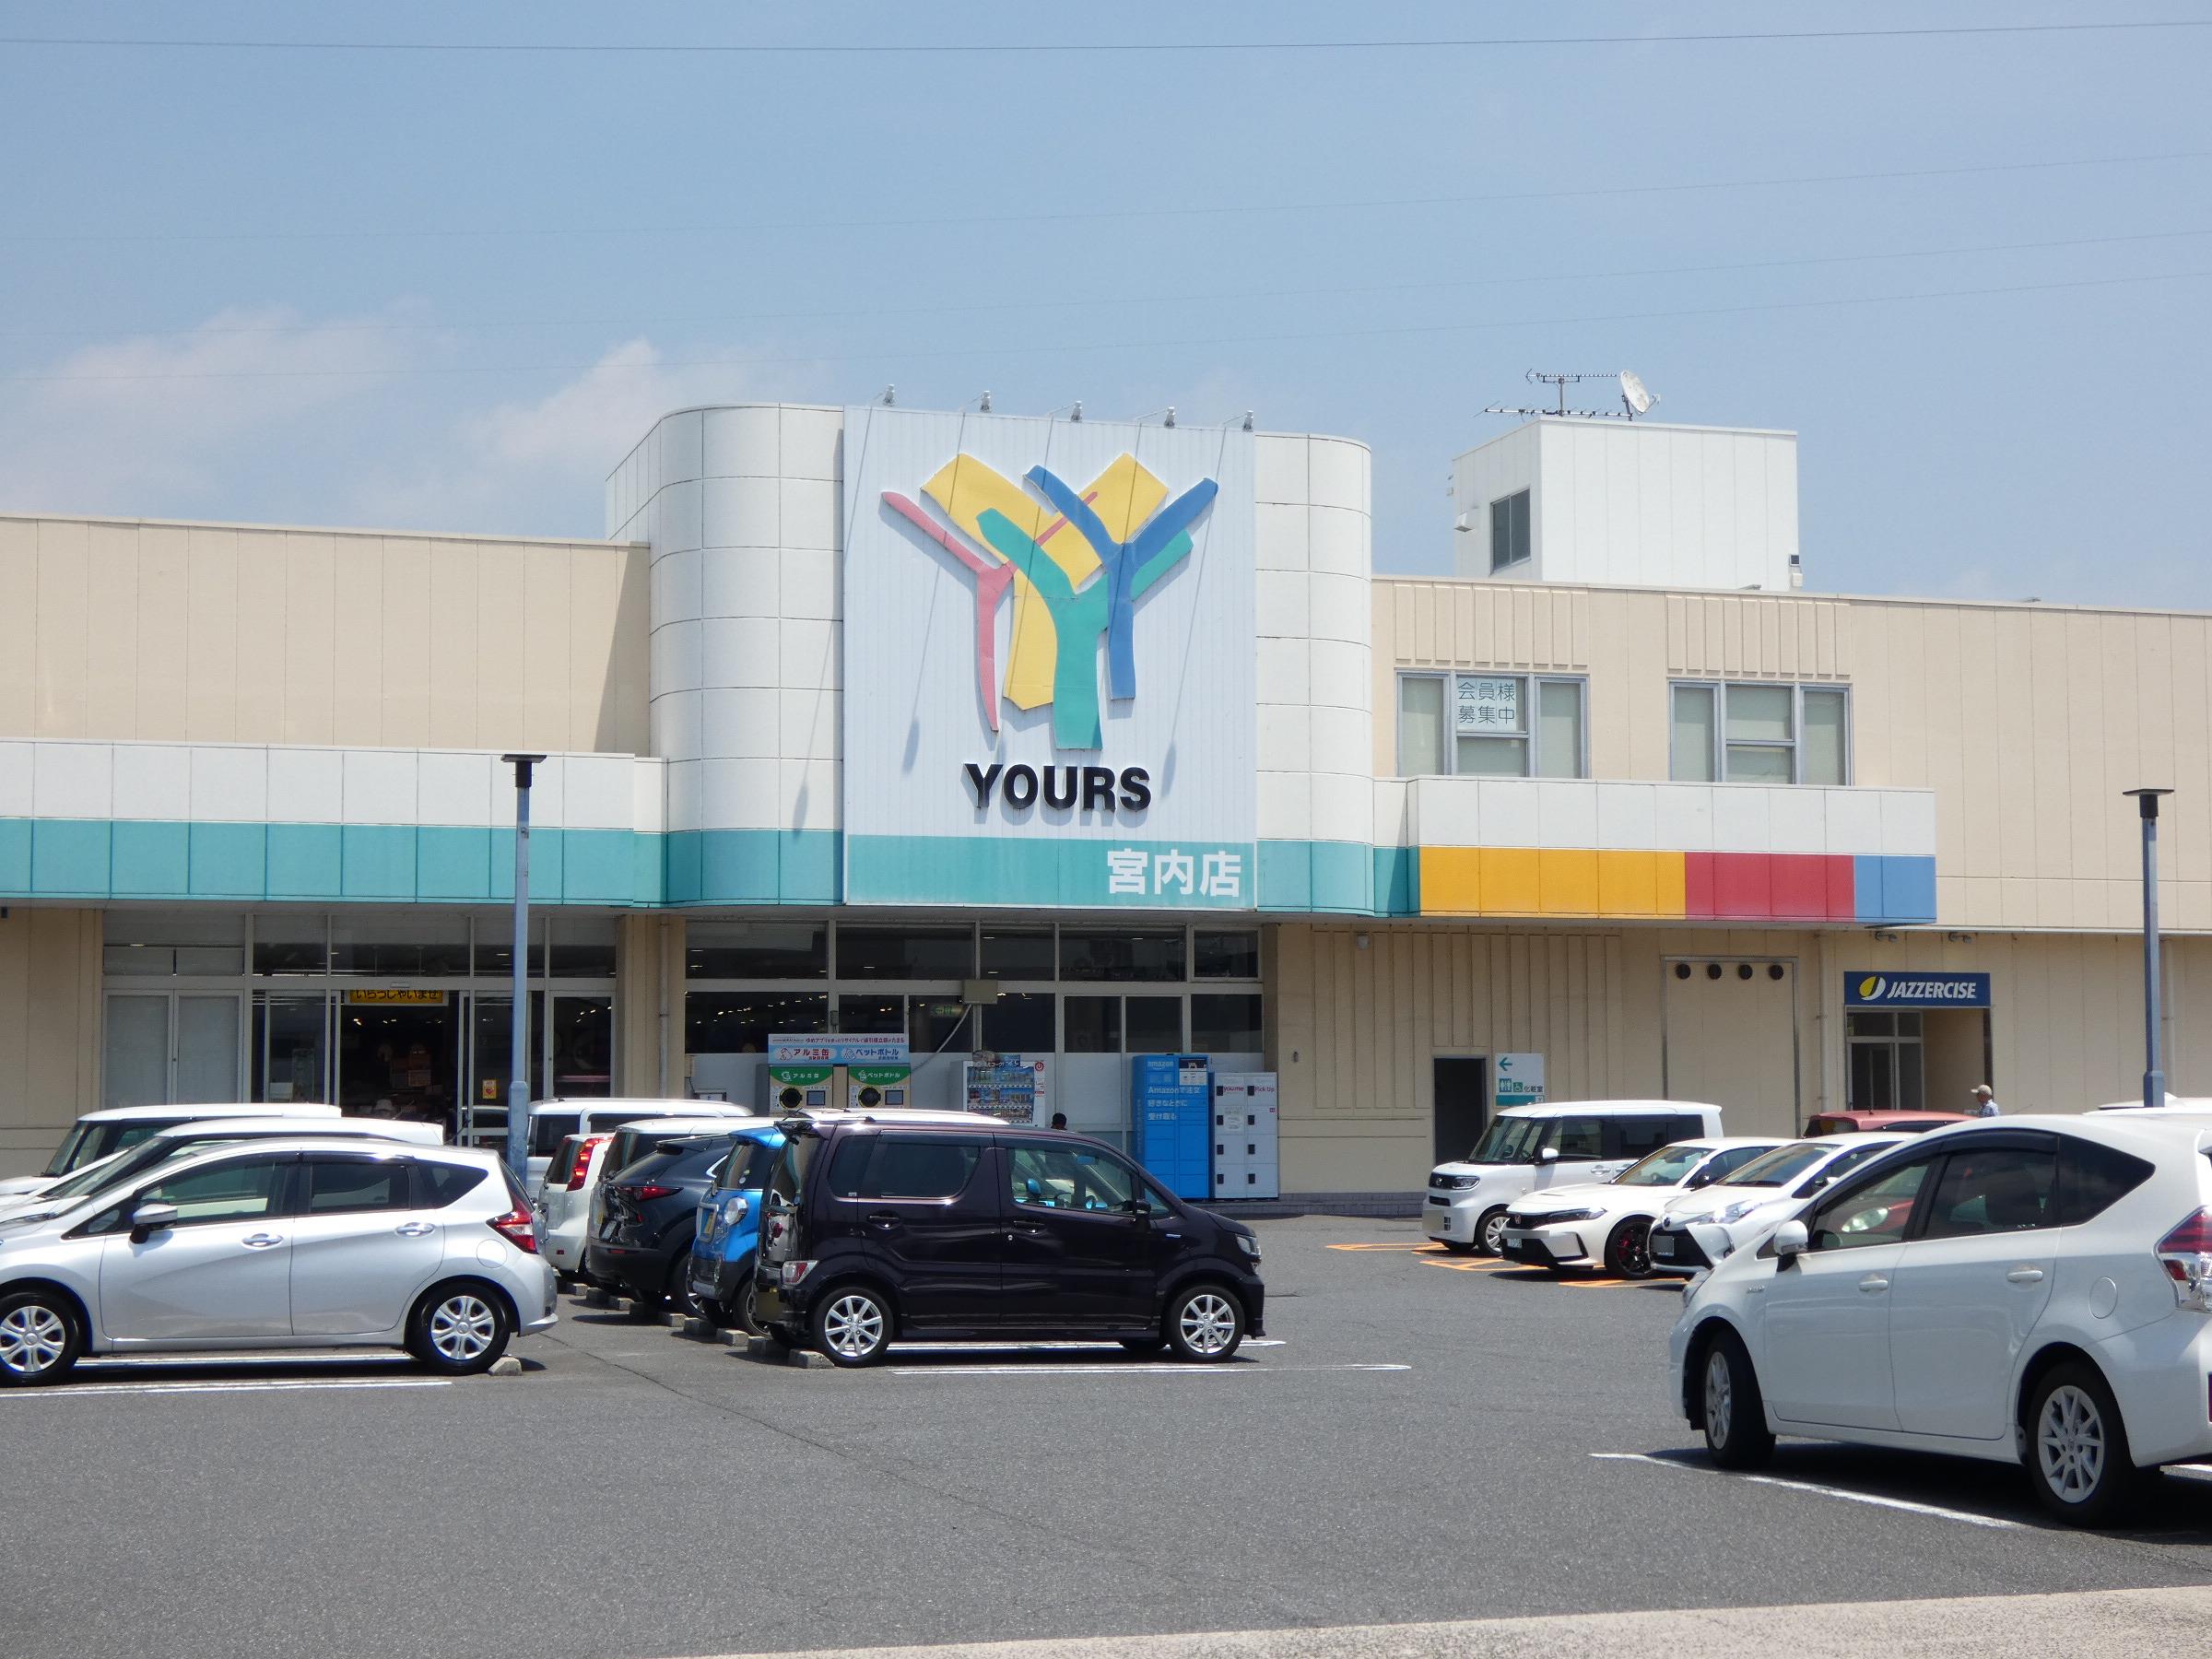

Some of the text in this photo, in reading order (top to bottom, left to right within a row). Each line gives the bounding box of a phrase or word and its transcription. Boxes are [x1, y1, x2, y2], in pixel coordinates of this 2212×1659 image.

[1458, 681, 1515, 700] 会員様
[1458, 705, 1515, 724] 募集中
[963, 763, 1152, 812] YOURS
[1107, 848, 1241, 898] 宮内店
[356, 989, 439, 999] いらっしゃいませ
[1887, 982, 1977, 999] JAZZERCISE
